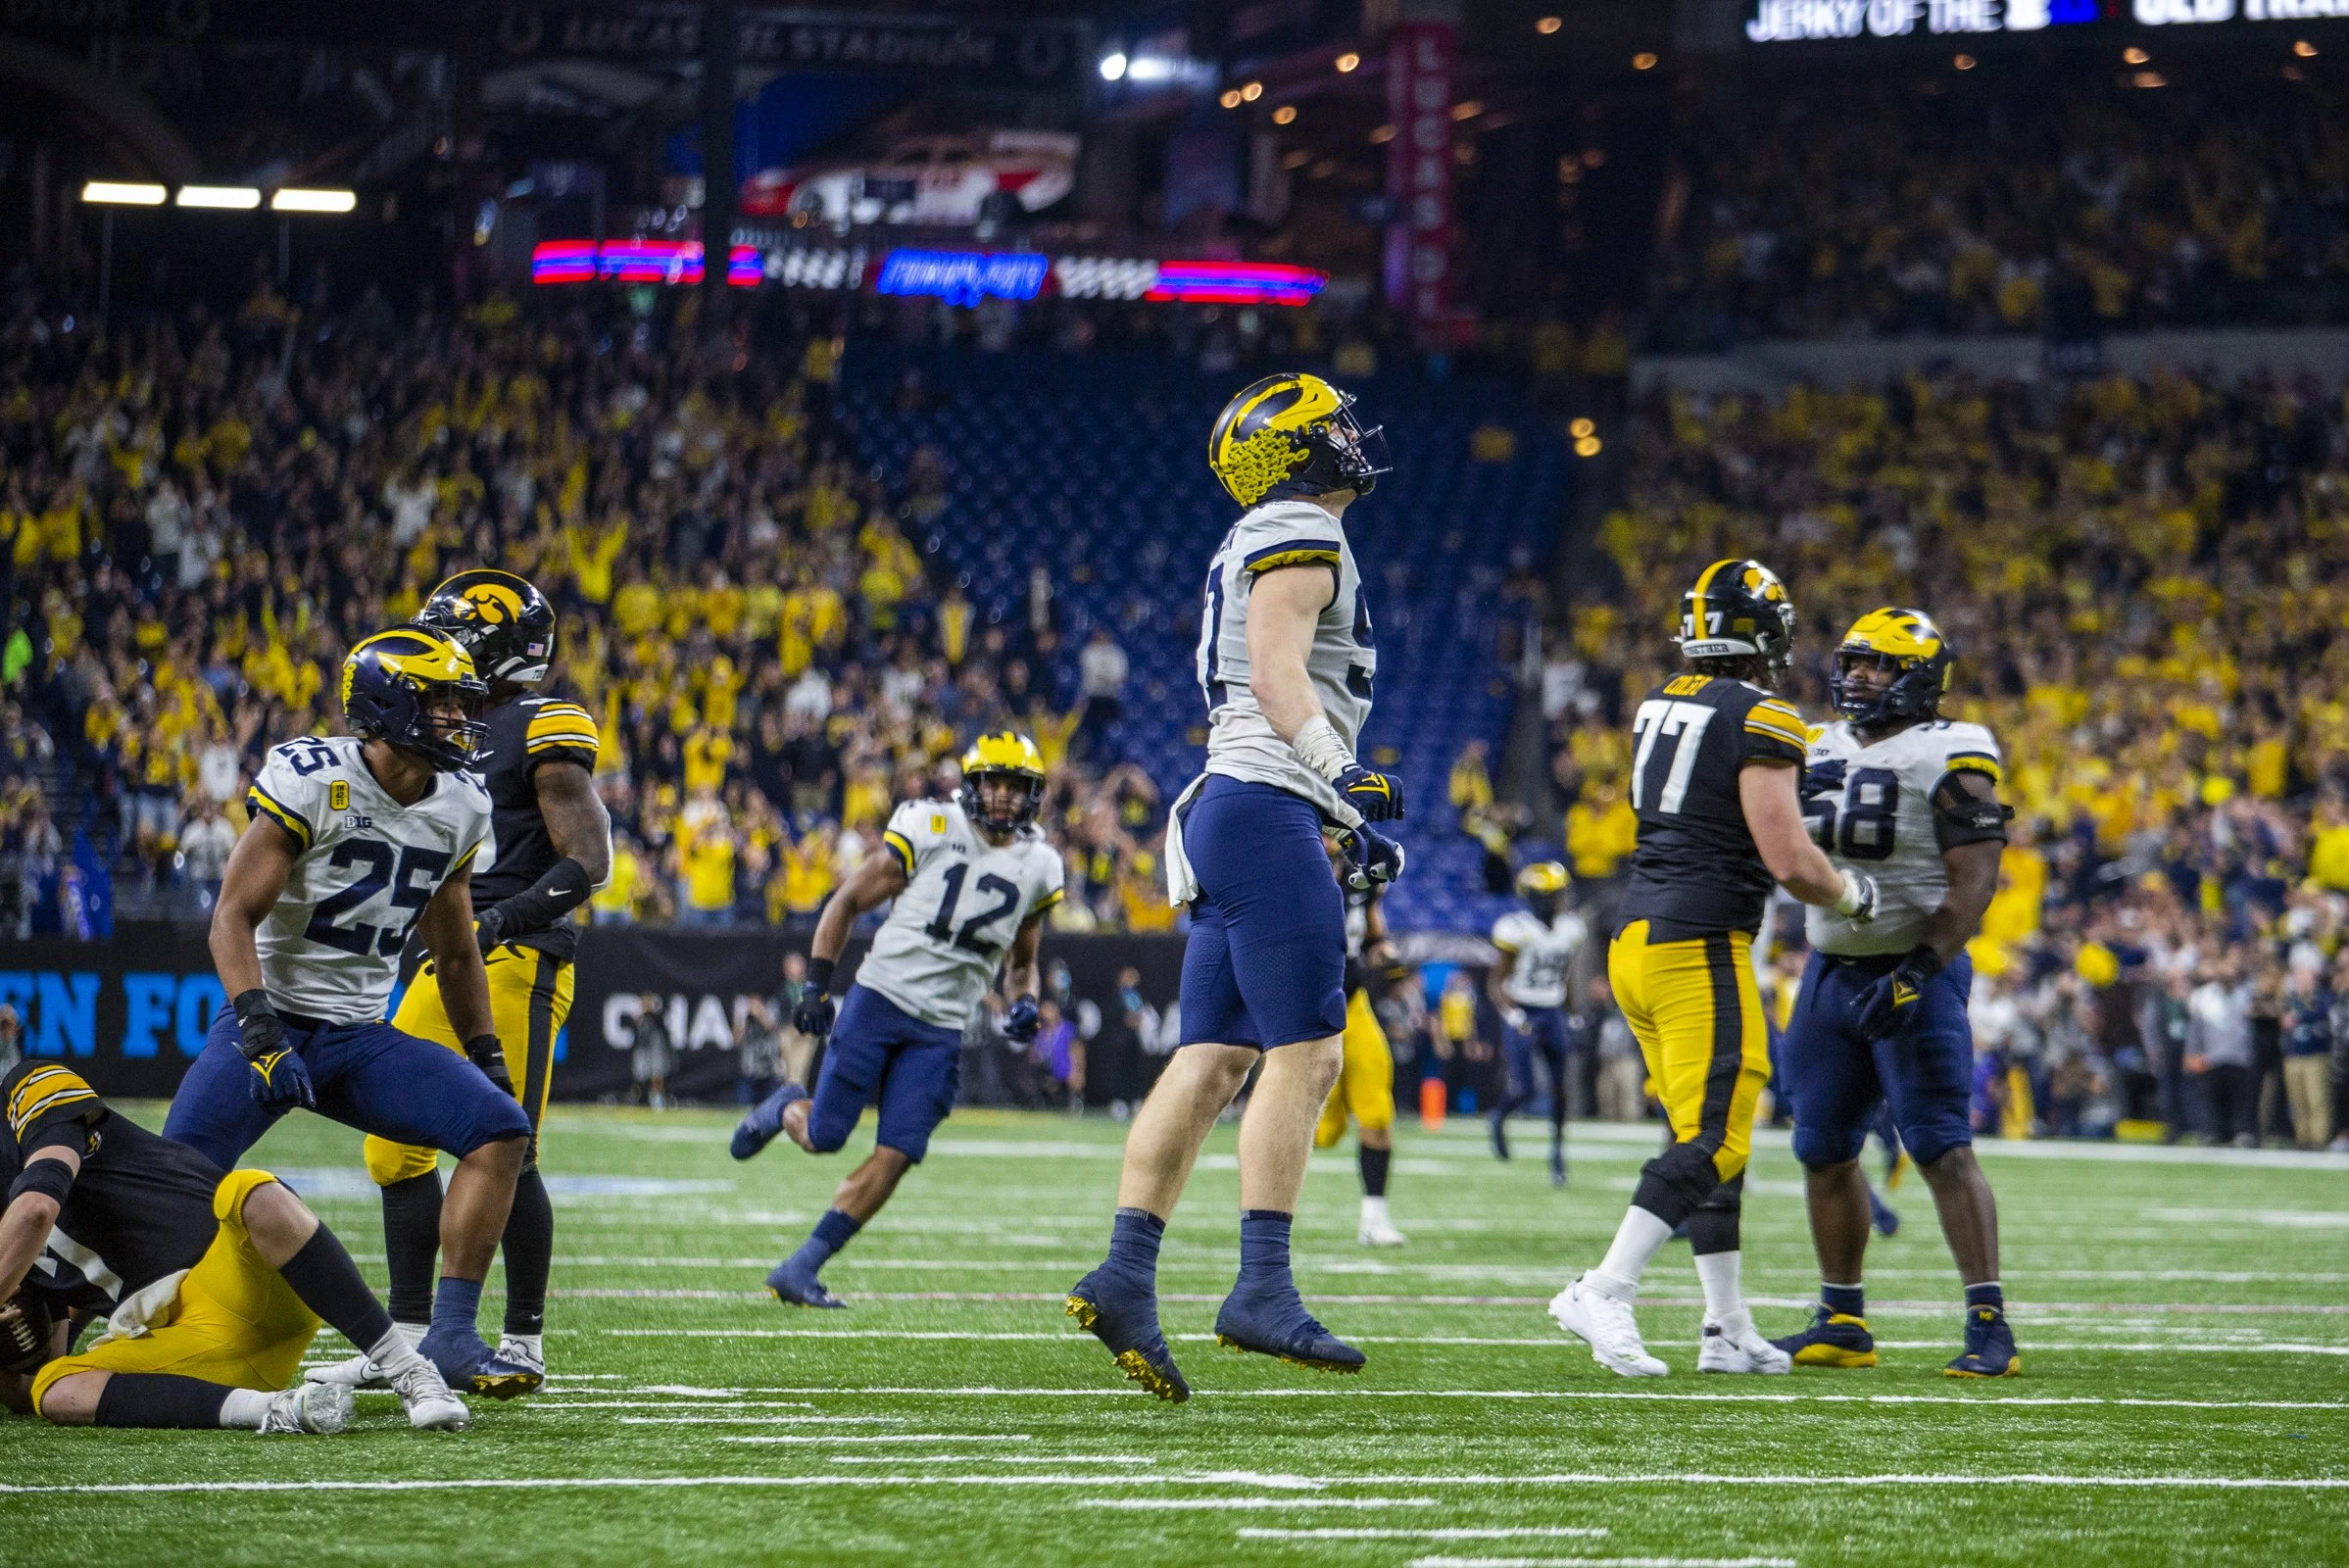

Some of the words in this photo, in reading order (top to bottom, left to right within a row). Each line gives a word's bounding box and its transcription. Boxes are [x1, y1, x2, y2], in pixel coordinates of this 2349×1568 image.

[1866, 0, 1928, 37] OF
[275, 735, 342, 777] 25
[1632, 699, 1718, 814] 77
[303, 837, 455, 957] 25
[924, 862, 1021, 957] 12
